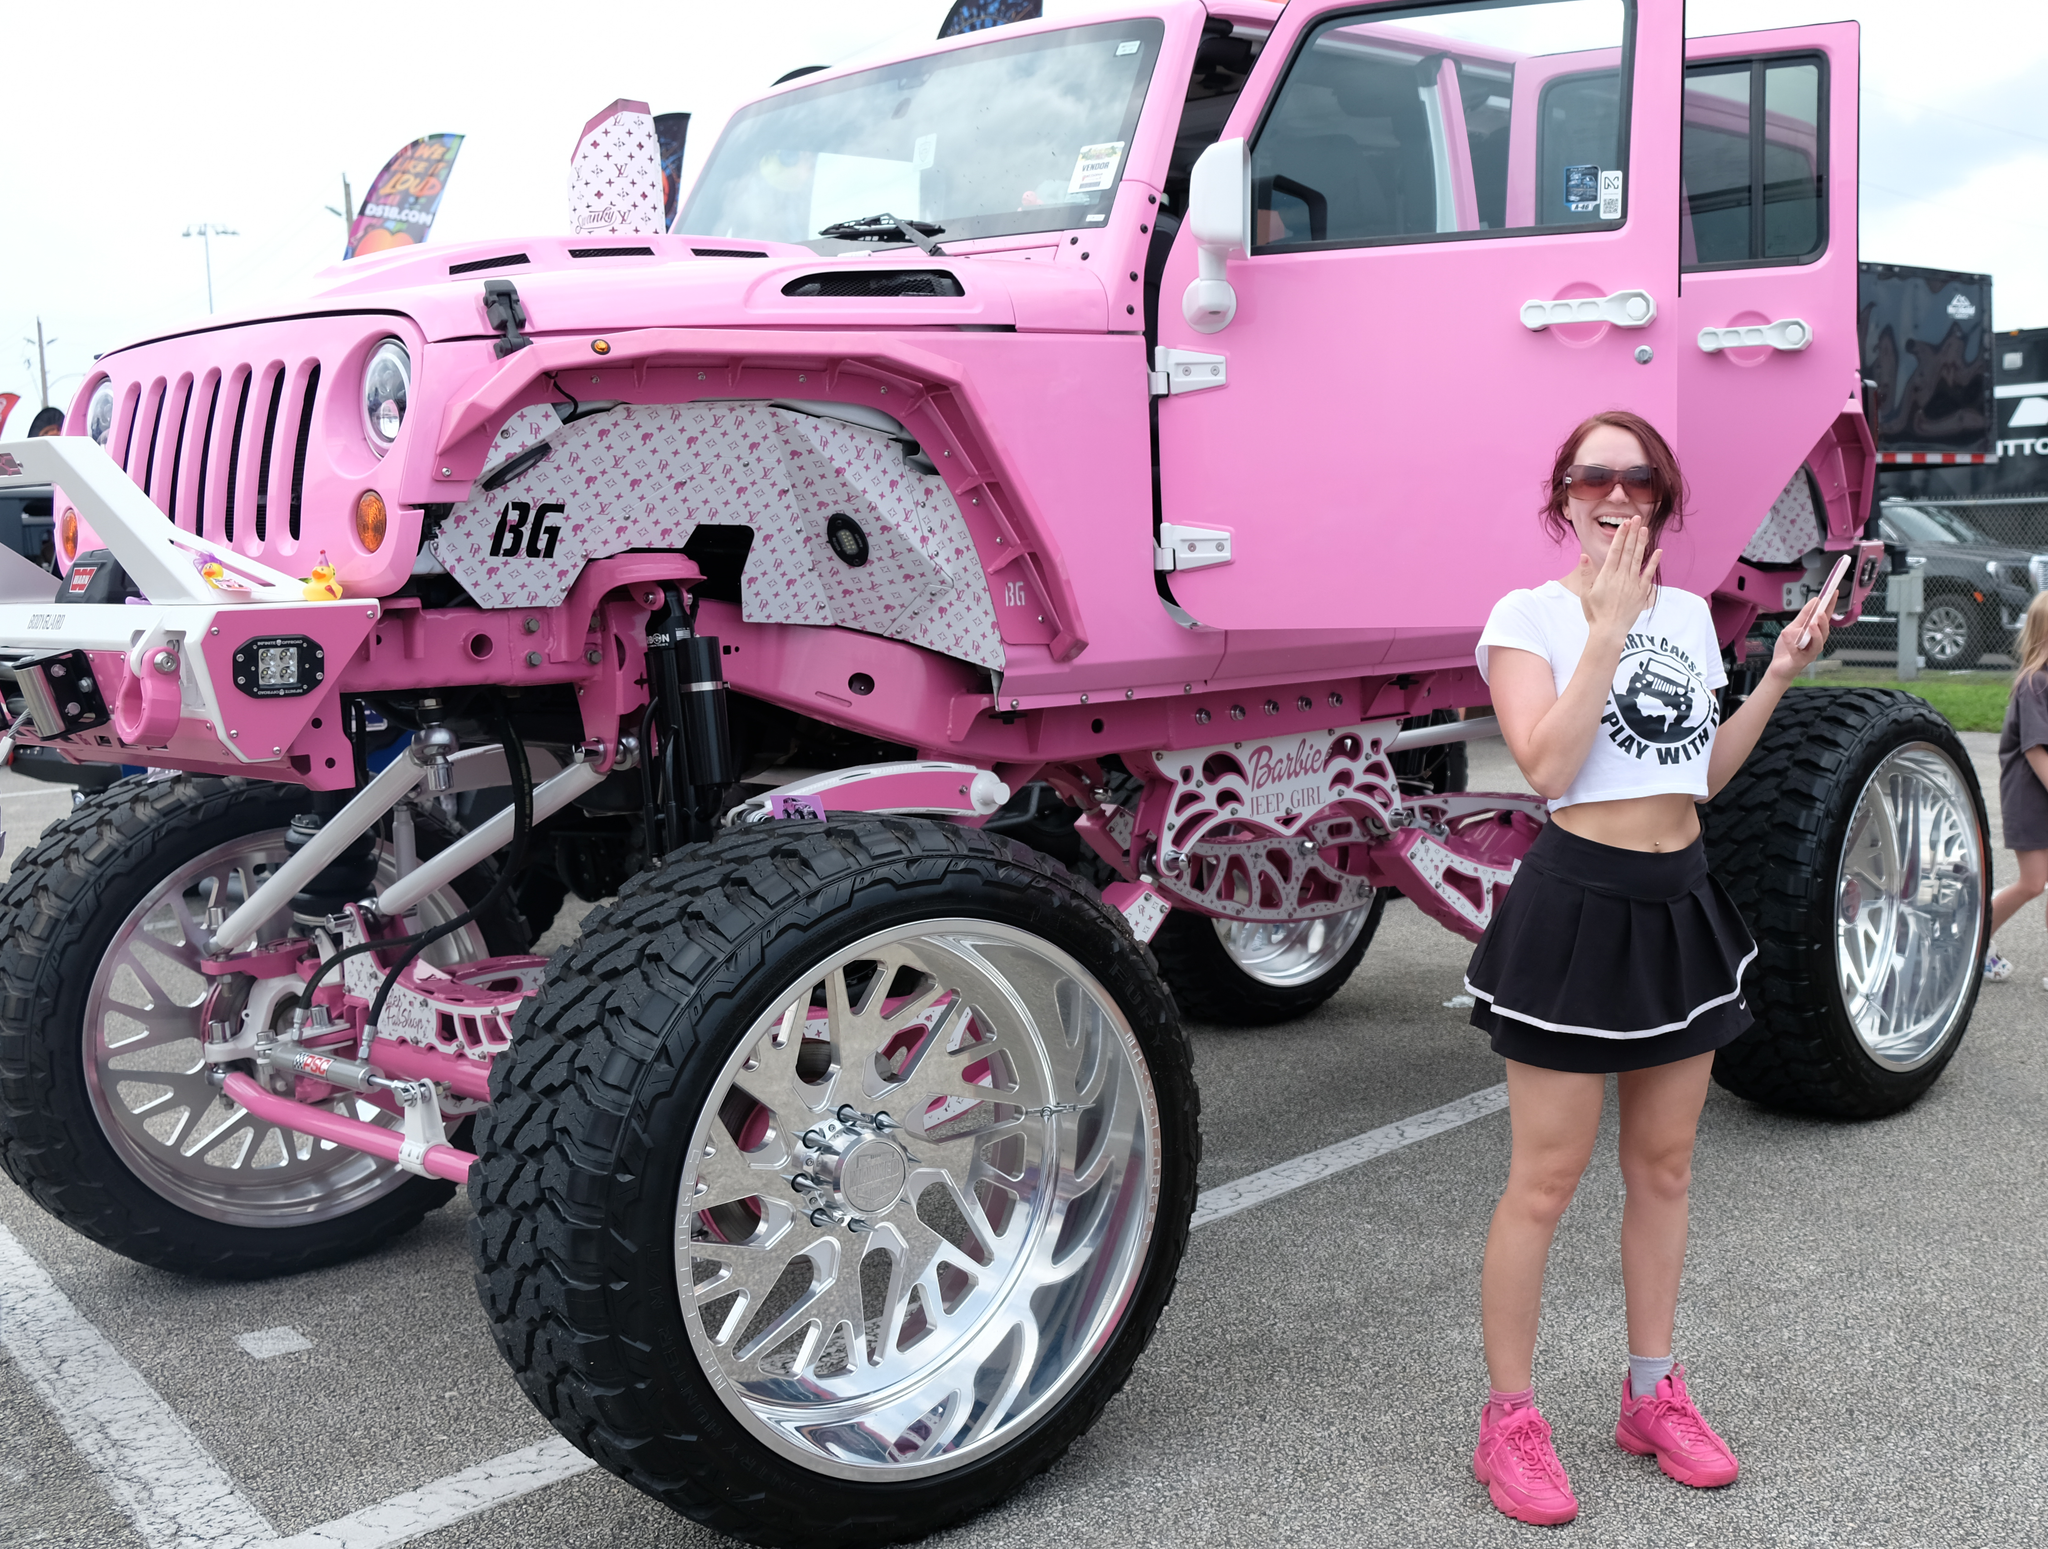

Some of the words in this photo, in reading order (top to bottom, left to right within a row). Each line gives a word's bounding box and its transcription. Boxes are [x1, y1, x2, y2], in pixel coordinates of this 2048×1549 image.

[414, 142, 447, 160] WE
[391, 158, 429, 174] LIKE
[1082, 161, 1110, 172] VENDOR
[379, 173, 442, 198] LOUD
[364, 203, 434, 226] DS18.COM
[1996, 437, 2048, 458] ITTO
[489, 501, 566, 558] BG
[1005, 581, 1025, 606] BG
[1621, 633, 1656, 652] IRTY
[1600, 711, 1651, 760] PLAY
[1655, 727, 1709, 765] WITH
[1248, 738, 1324, 793] Barbie
[1250, 792, 1285, 818] JEEP
[1290, 786, 1326, 809] GIRL
[1109, 962, 1164, 1047] FURY
[303, 1054, 331, 1076] PSC
